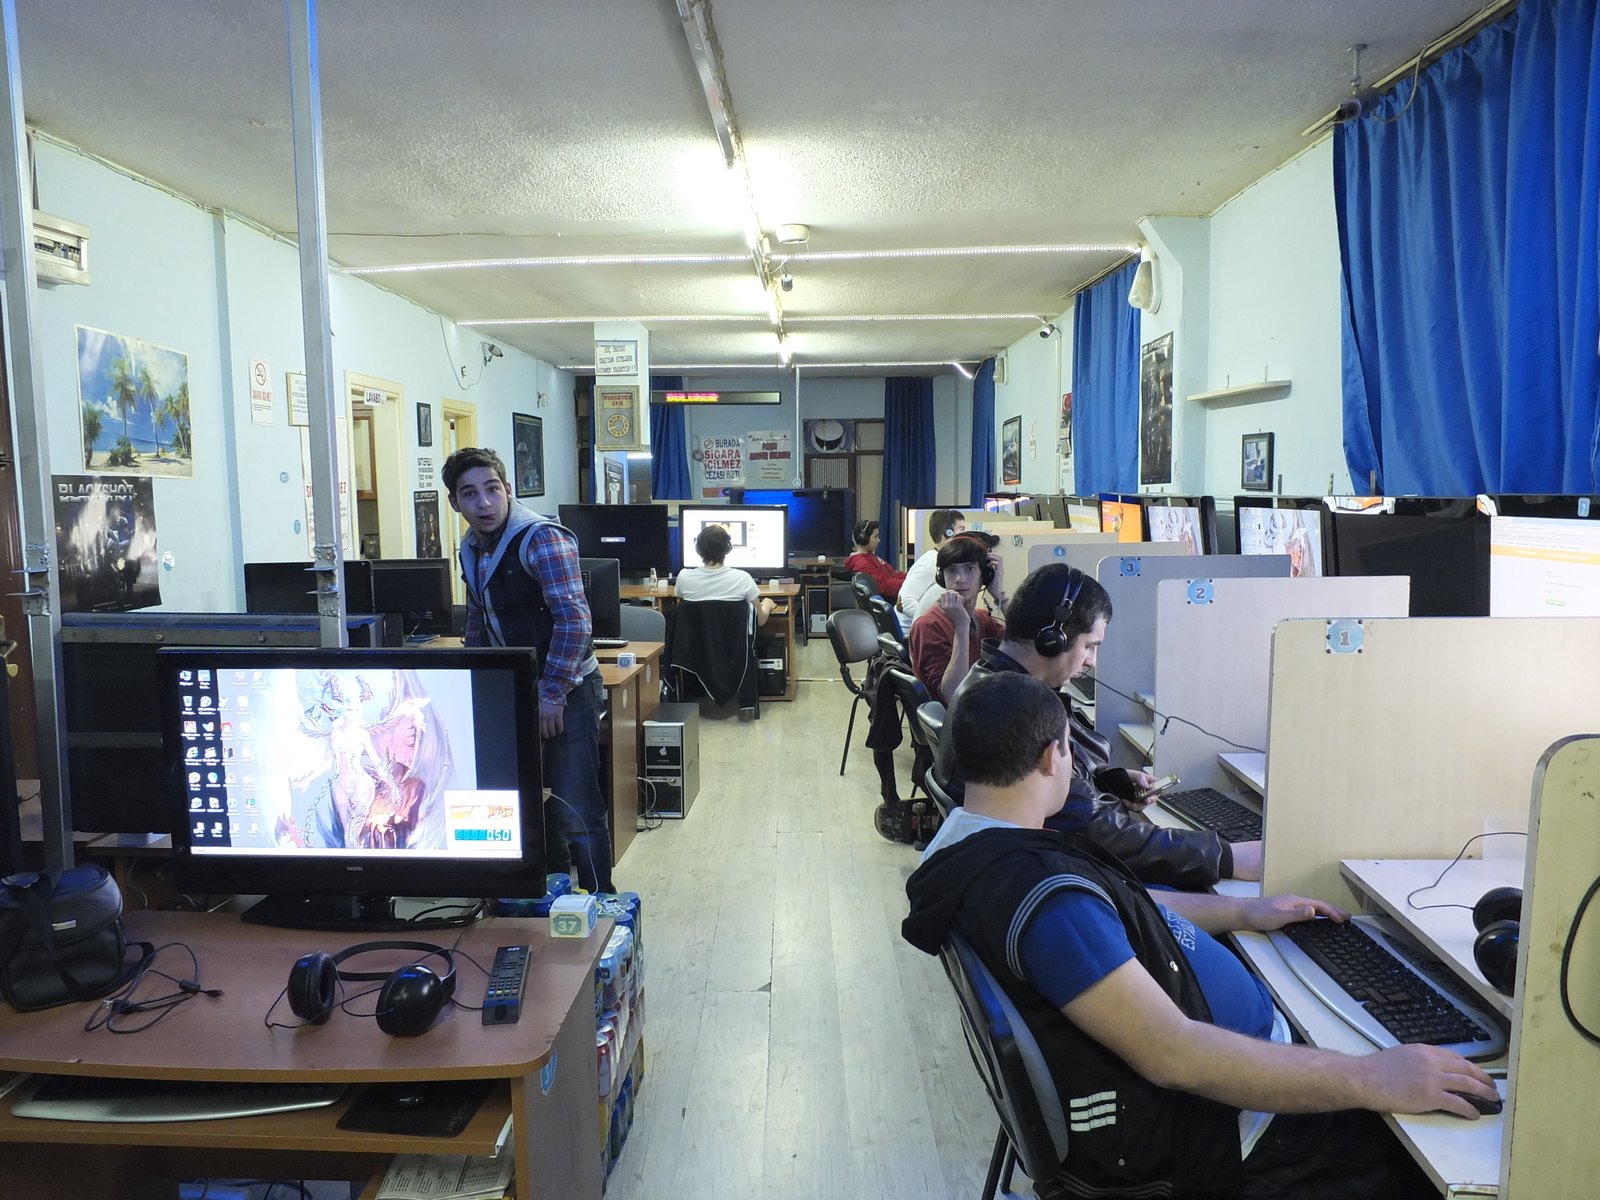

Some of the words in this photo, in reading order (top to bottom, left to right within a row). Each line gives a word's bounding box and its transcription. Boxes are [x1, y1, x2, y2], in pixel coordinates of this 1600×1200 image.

[715, 439, 741, 448] BURADA
[1126, 563, 1135, 573] 3
[1195, 587, 1206, 600] 2
[1339, 629, 1351, 648] 1
[557, 920, 578, 932] 37
